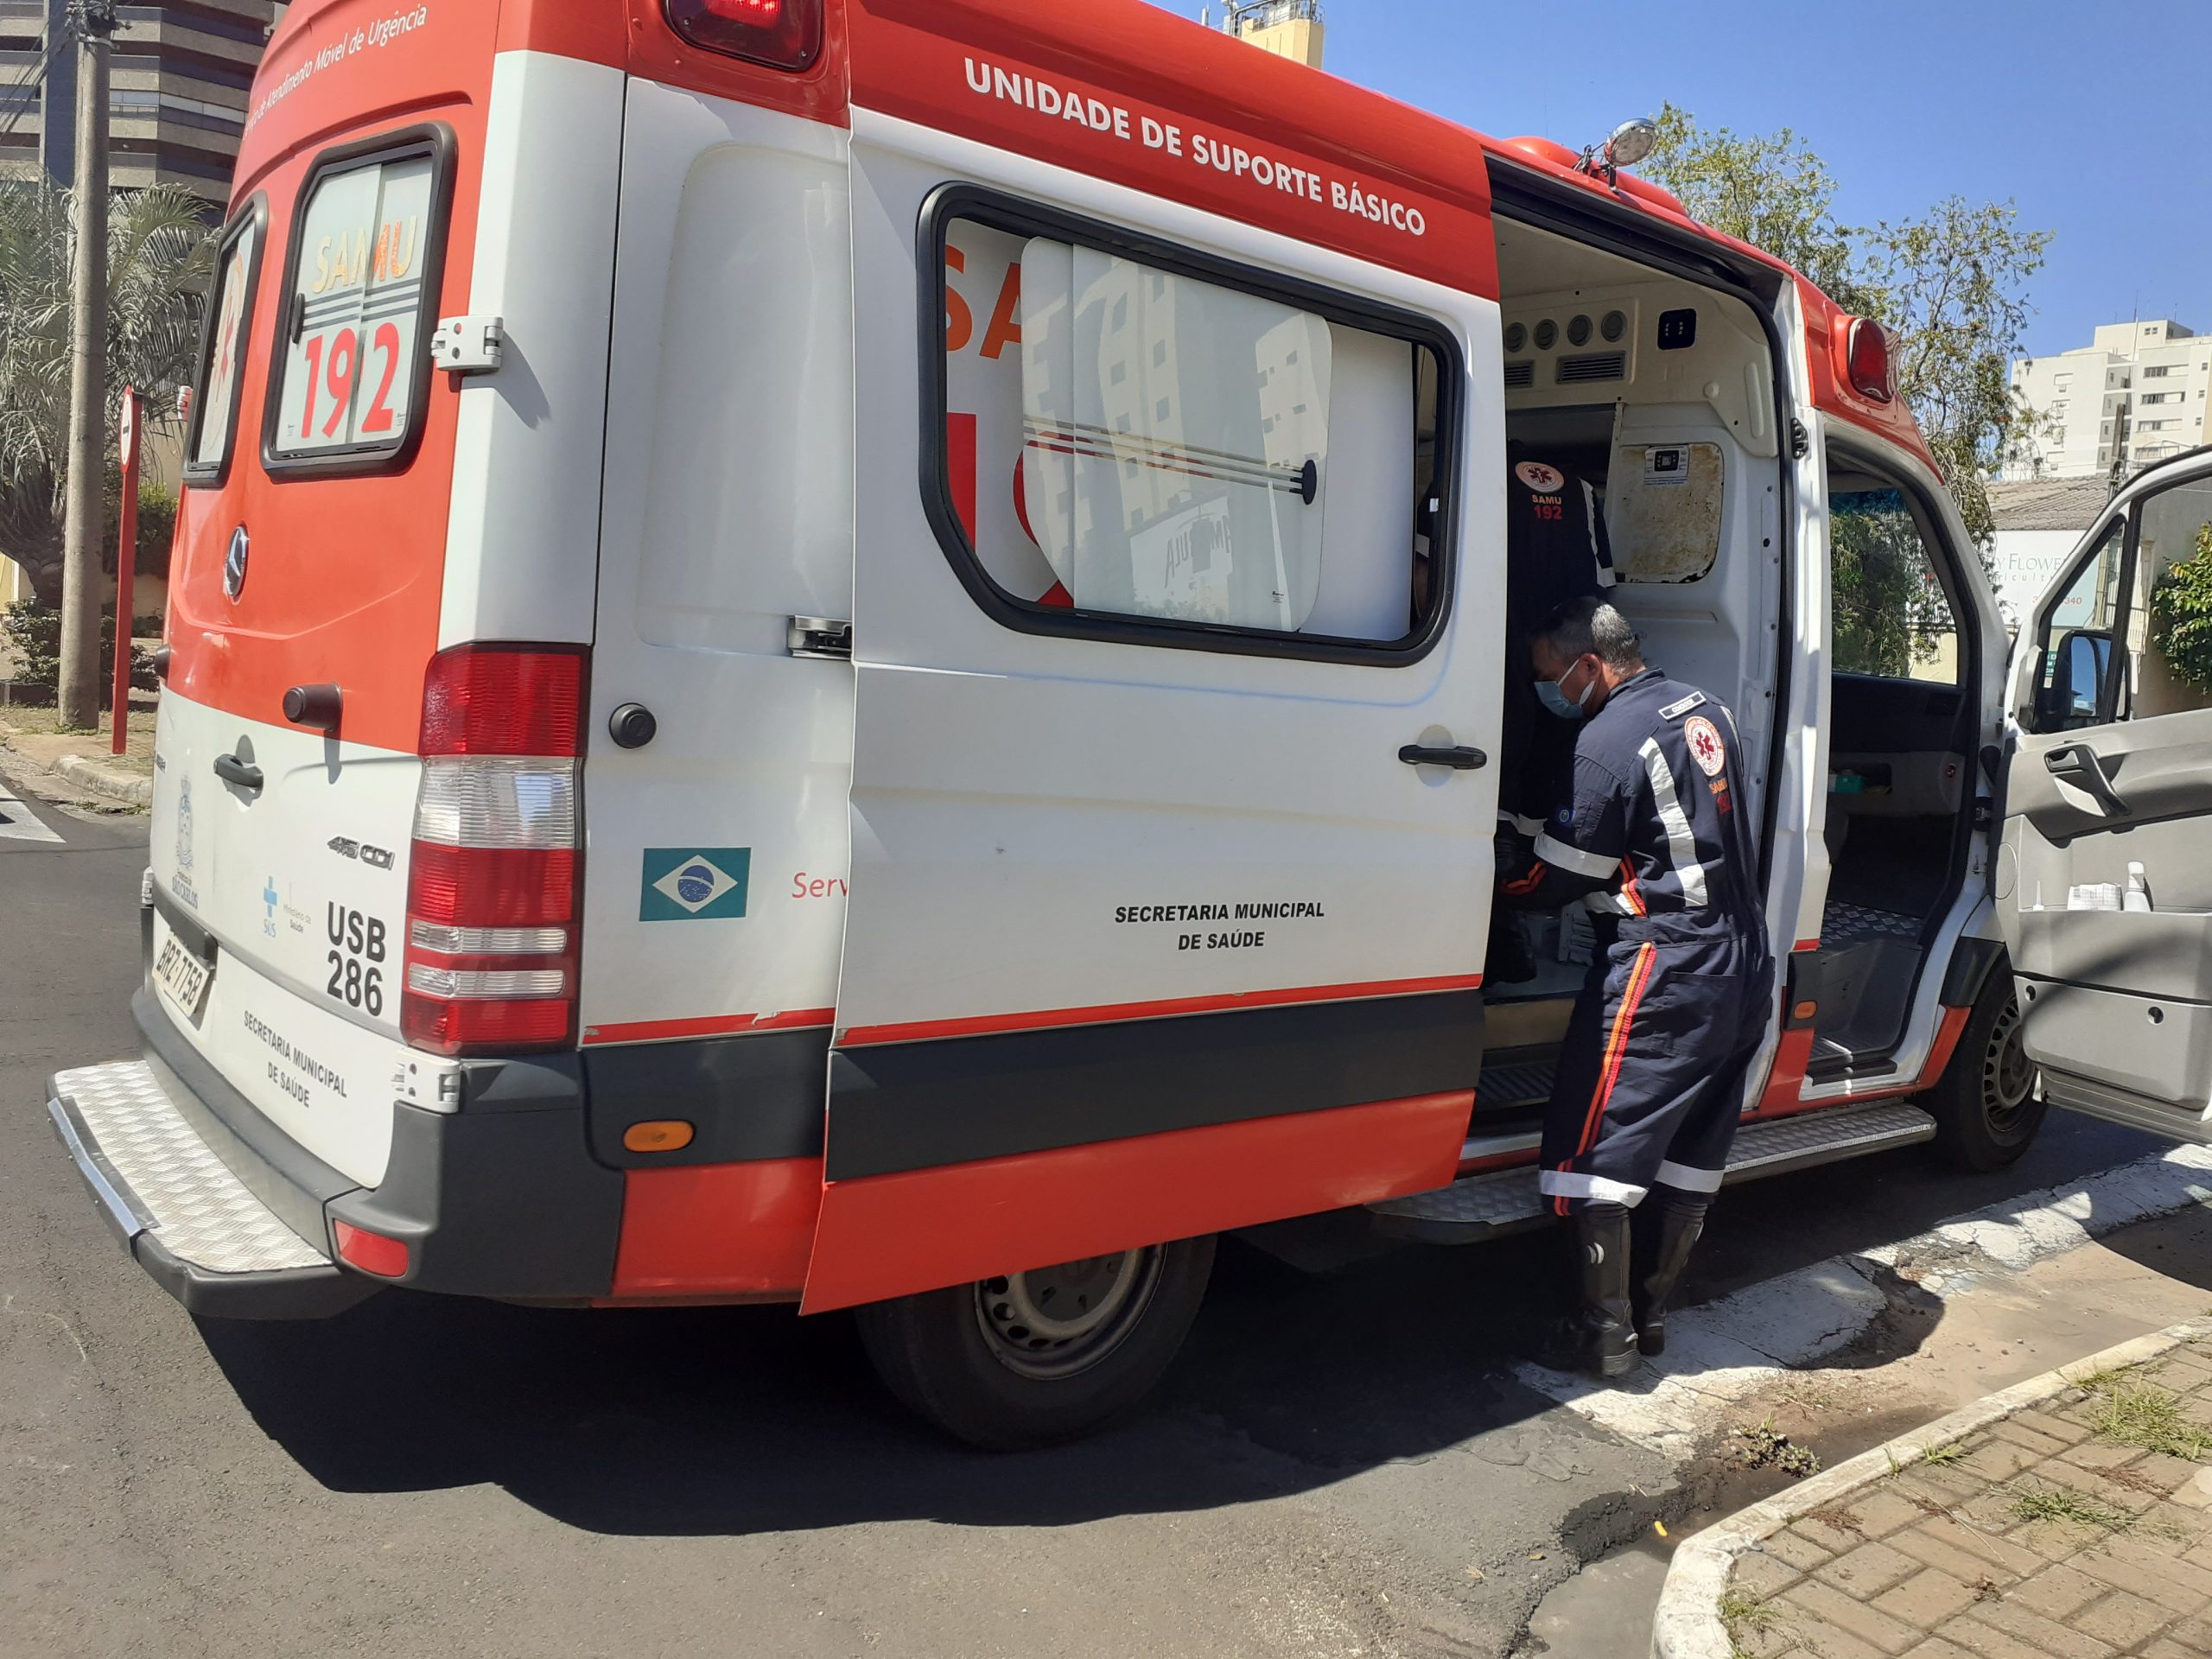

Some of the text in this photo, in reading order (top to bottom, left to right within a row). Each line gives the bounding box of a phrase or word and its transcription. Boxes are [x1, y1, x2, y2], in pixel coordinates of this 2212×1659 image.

[266, 60, 313, 111] Atendimento
[315, 33, 347, 73] Móvel
[348, 27, 365, 54] de
[368, 4, 428, 47] Urgência
[964, 57, 1426, 236] UNIDADE DE SUPORTE BÁSICO
[312, 215, 416, 294] SAMU
[300, 321, 400, 438] 192
[1531, 494, 1562, 505] SAMU
[1534, 505, 1563, 520] 192
[359, 844, 396, 871] CDI
[264, 918, 276, 938] SUS
[327, 900, 386, 963] USB
[1115, 902, 1325, 923] SECRETARIA MUNICIPAL
[1178, 929, 1265, 950] DE SAÚDE
[327, 950, 384, 1017] 286
[244, 1009, 347, 1098] SECRETARIA MUNICIPAL
[268, 1061, 310, 1108] DE SAÚDE
